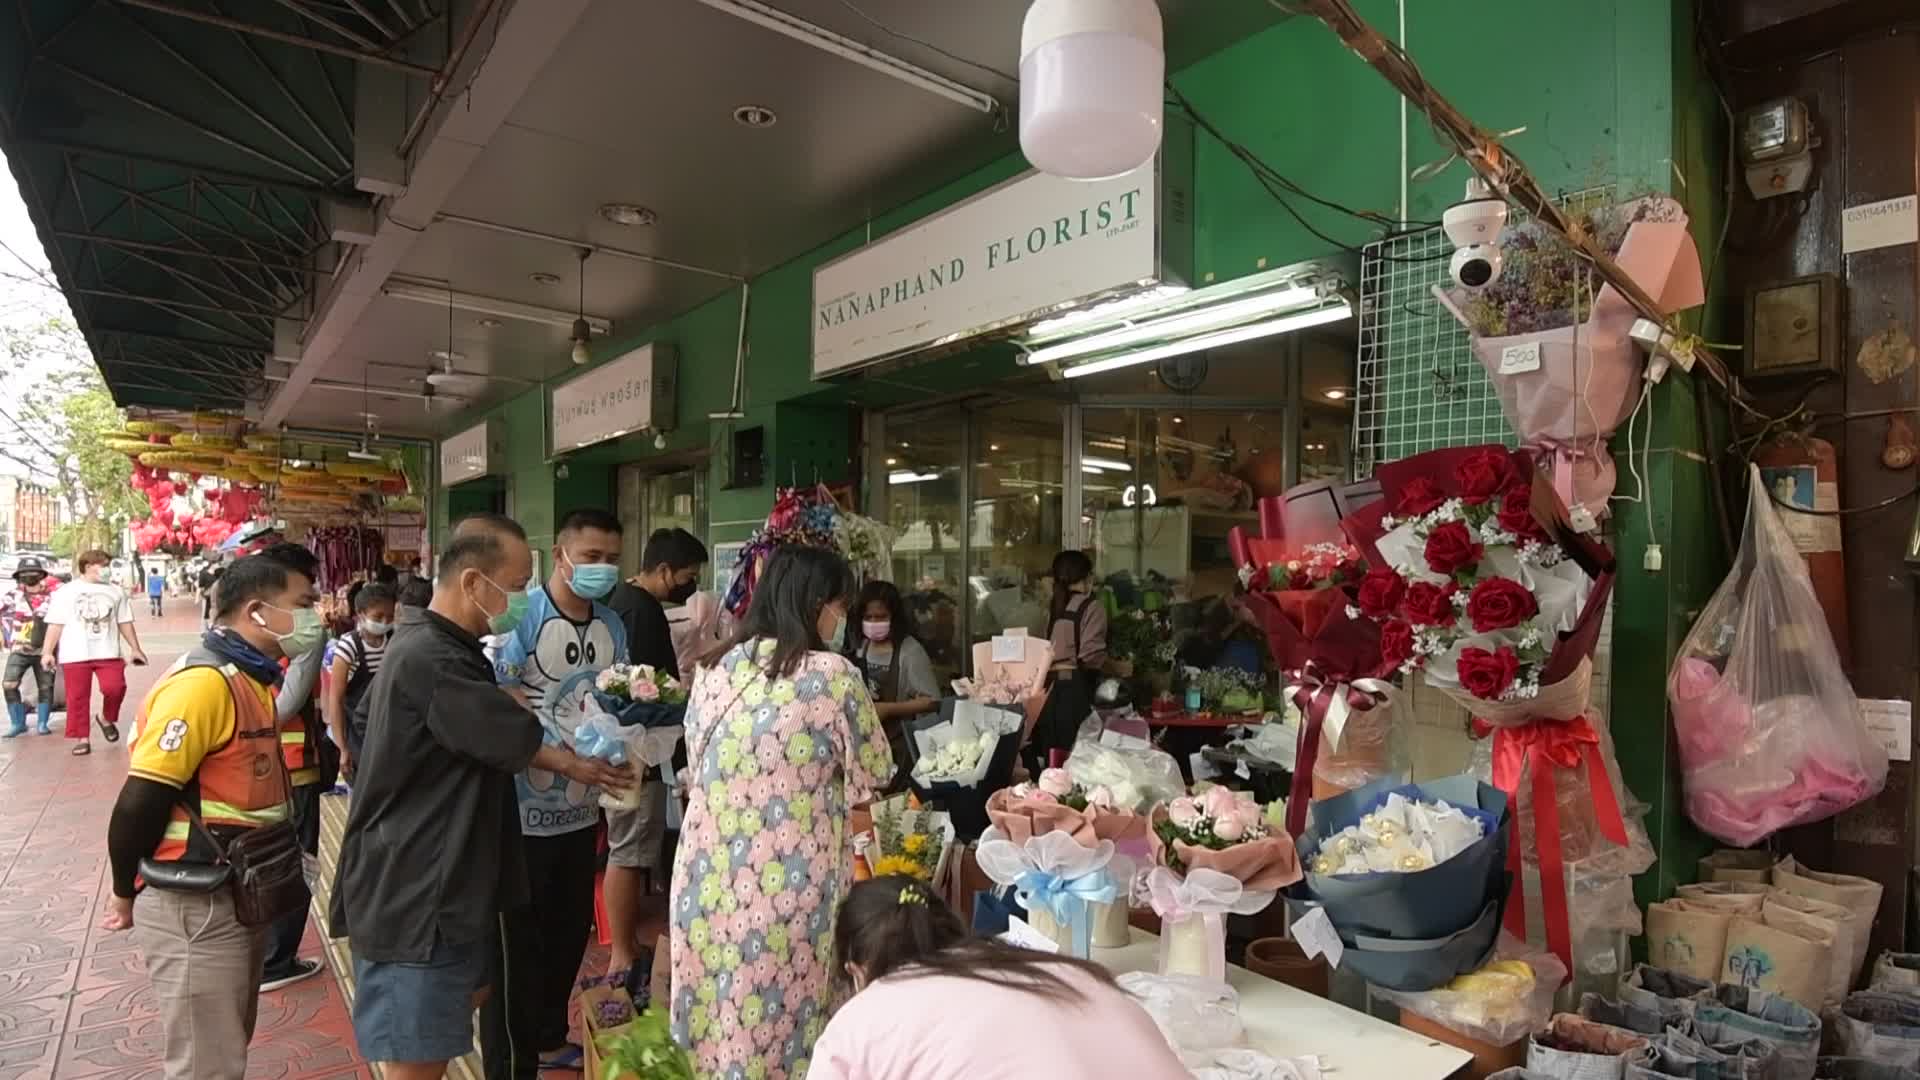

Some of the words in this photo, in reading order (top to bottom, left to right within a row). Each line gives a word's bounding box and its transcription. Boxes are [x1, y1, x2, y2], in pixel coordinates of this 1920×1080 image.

[820, 258, 965, 330] NANAPHAND
[987, 189, 1141, 271] FLORIST
[1504, 349, 1536, 367] 500
[158, 718, 188, 752] 8
